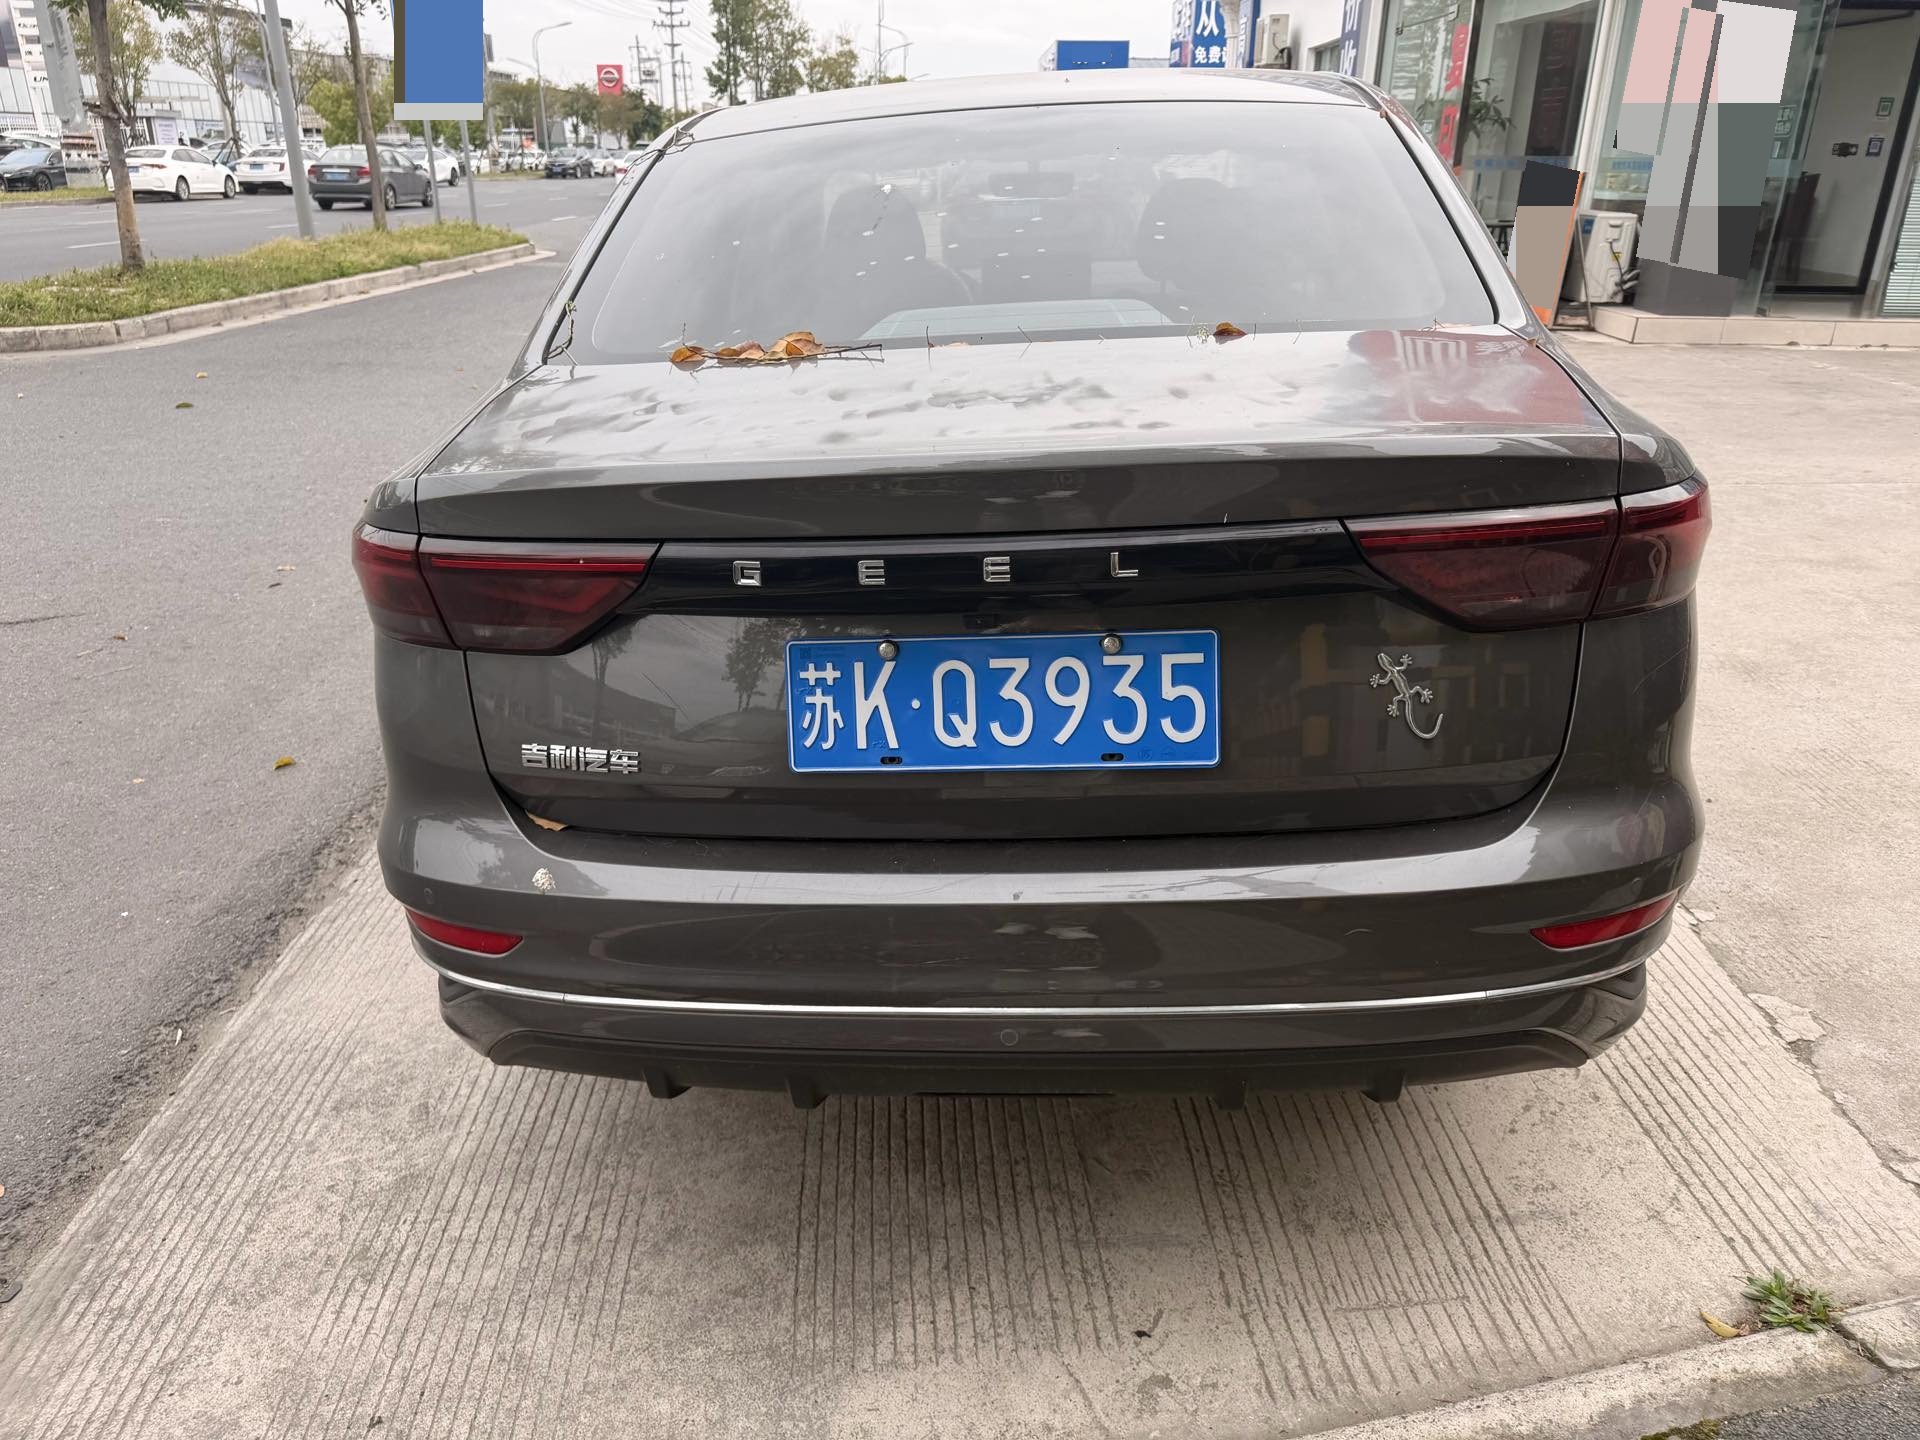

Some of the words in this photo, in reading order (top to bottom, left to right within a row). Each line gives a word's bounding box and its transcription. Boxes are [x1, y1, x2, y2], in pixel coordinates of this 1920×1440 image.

[732, 552, 1139, 587] GEEL
[799, 652, 1208, 750] 苏K·Q3935
[521, 743, 639, 774] 吉利汽车
